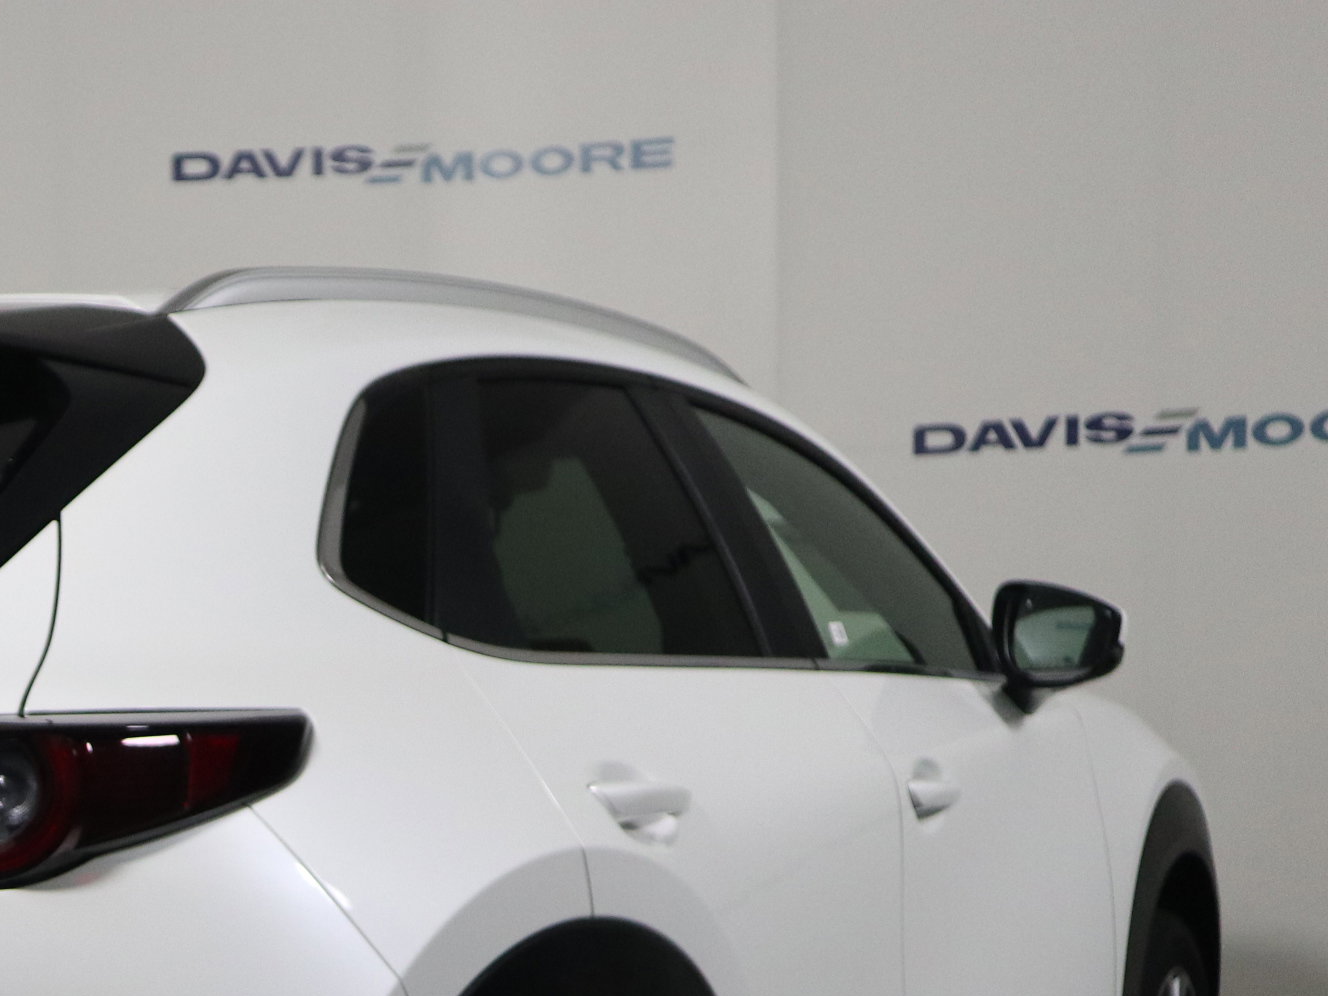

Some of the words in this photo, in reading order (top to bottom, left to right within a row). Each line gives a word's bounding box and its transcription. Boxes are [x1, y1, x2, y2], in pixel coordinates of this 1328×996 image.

[171, 144, 373, 183] DAVIS
[422, 137, 675, 184] MOORE
[913, 411, 1135, 455] DAVIS
